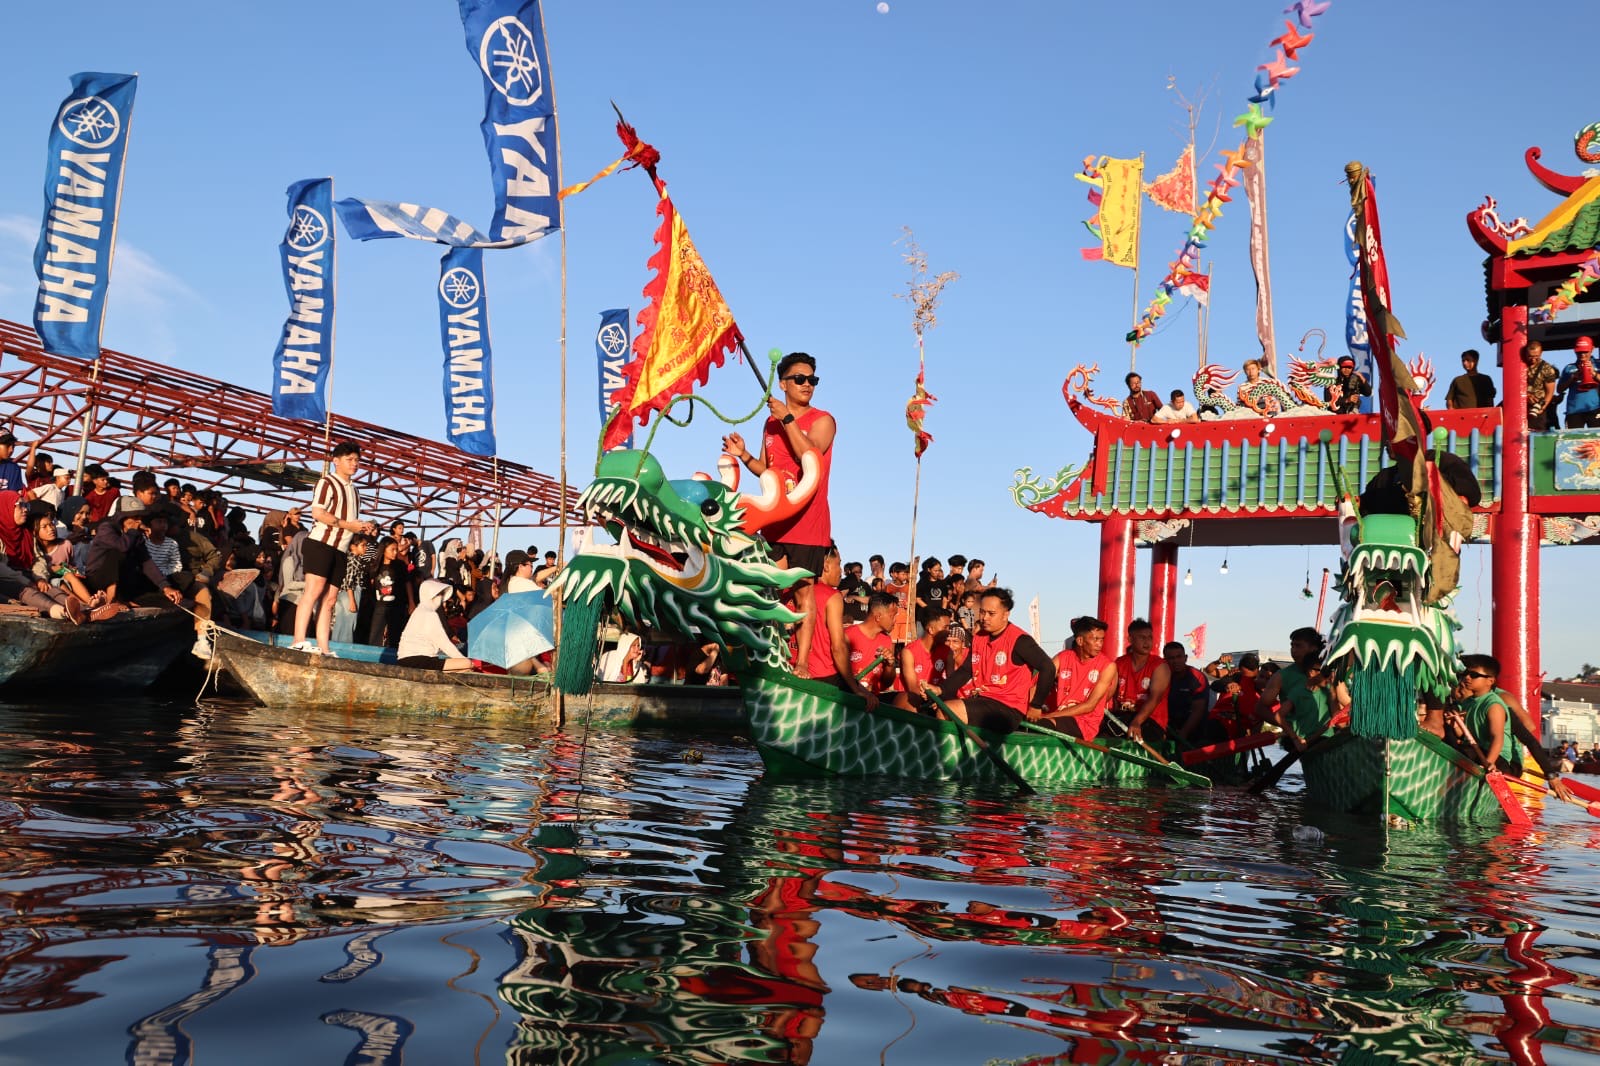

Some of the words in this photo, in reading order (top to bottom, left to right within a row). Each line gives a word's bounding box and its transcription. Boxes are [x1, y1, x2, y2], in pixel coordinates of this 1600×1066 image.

[37, 149, 111, 323] YAMAHA
[280, 250, 324, 394] YAMAHA
[447, 307, 486, 436] YAMAHA
[657, 344, 696, 377] POTONG
